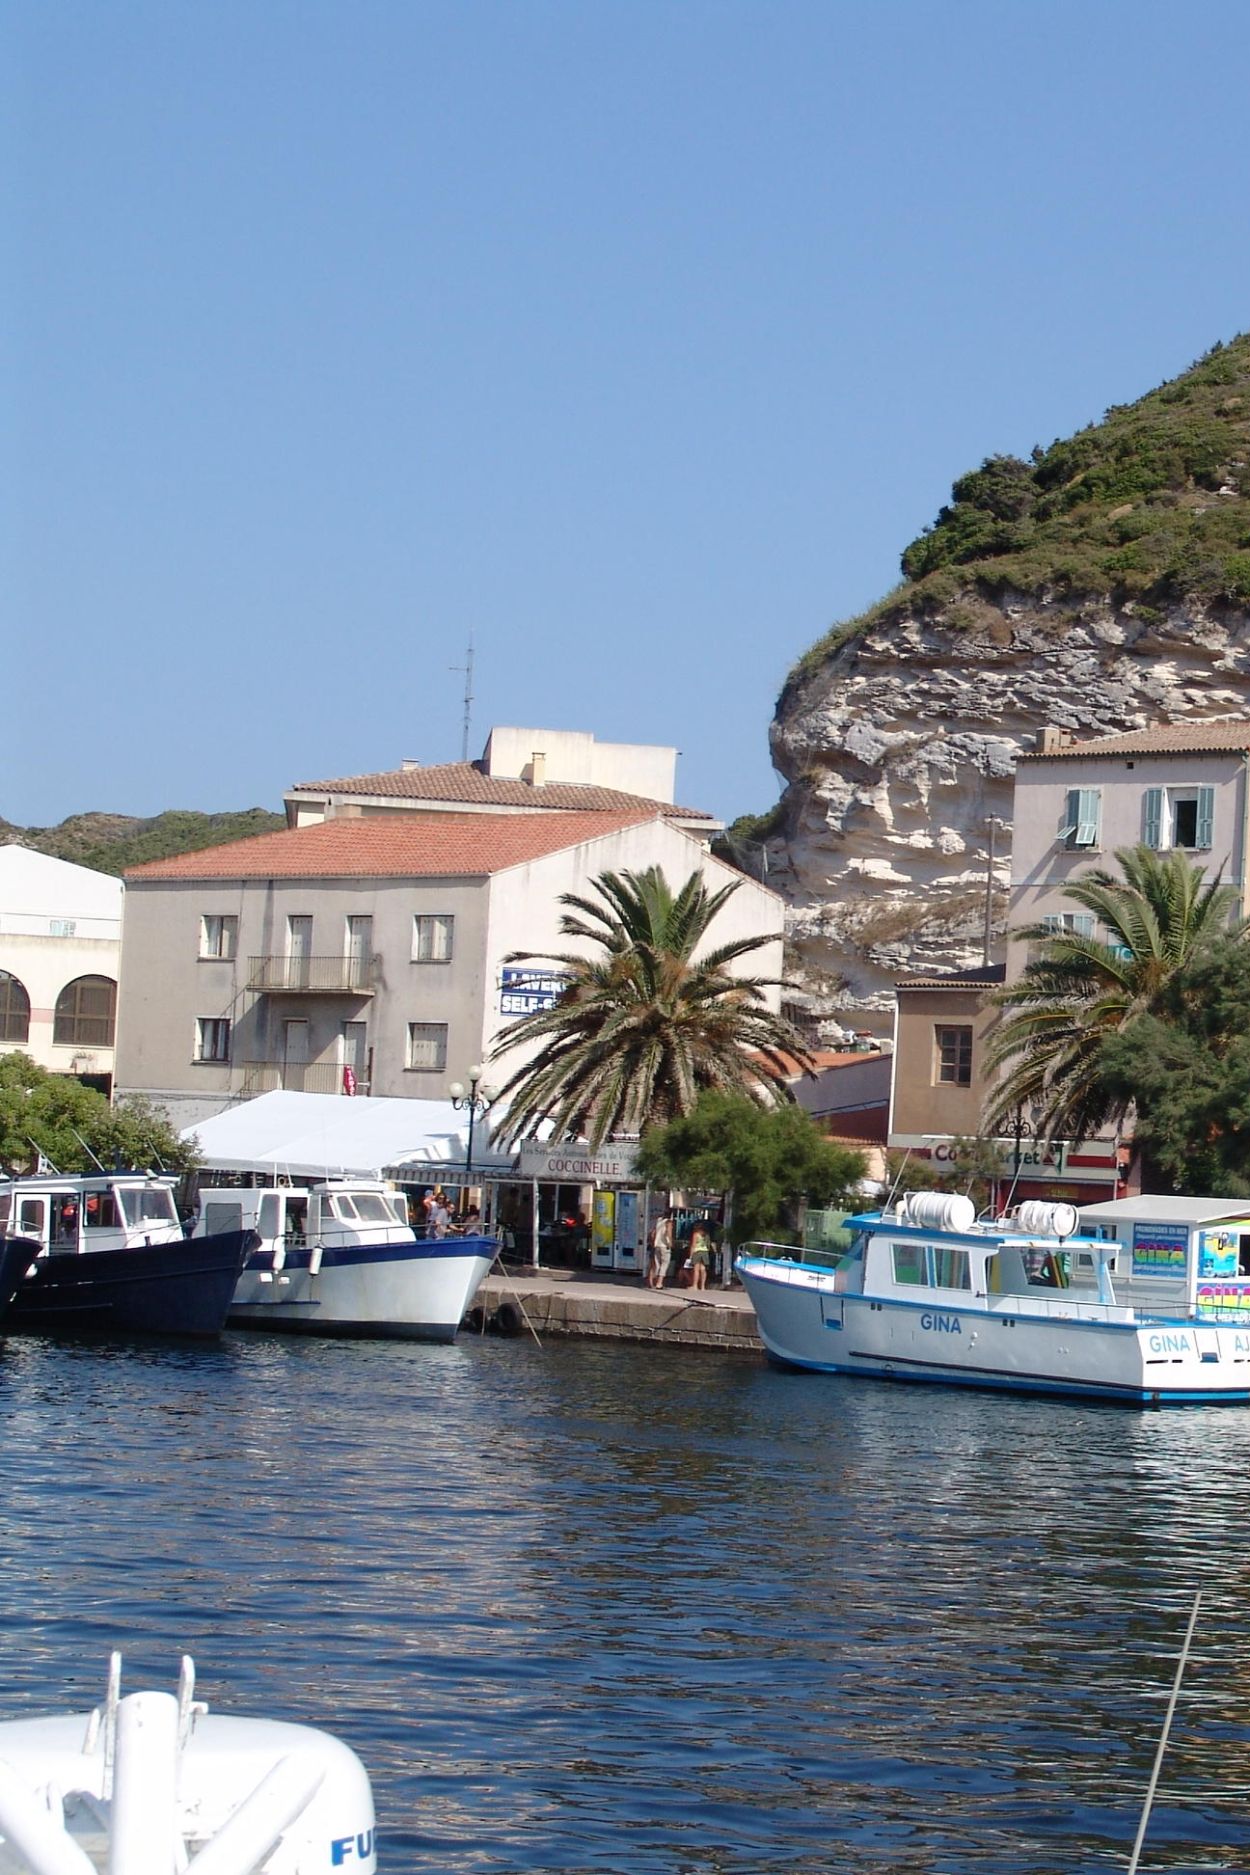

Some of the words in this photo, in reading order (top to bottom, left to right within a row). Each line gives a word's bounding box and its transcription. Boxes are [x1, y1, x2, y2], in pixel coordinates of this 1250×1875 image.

[921, 1314, 962, 1334] GINA
[1149, 1334, 1191, 1353] GINA
[1235, 1335, 1250, 1352] AJ
